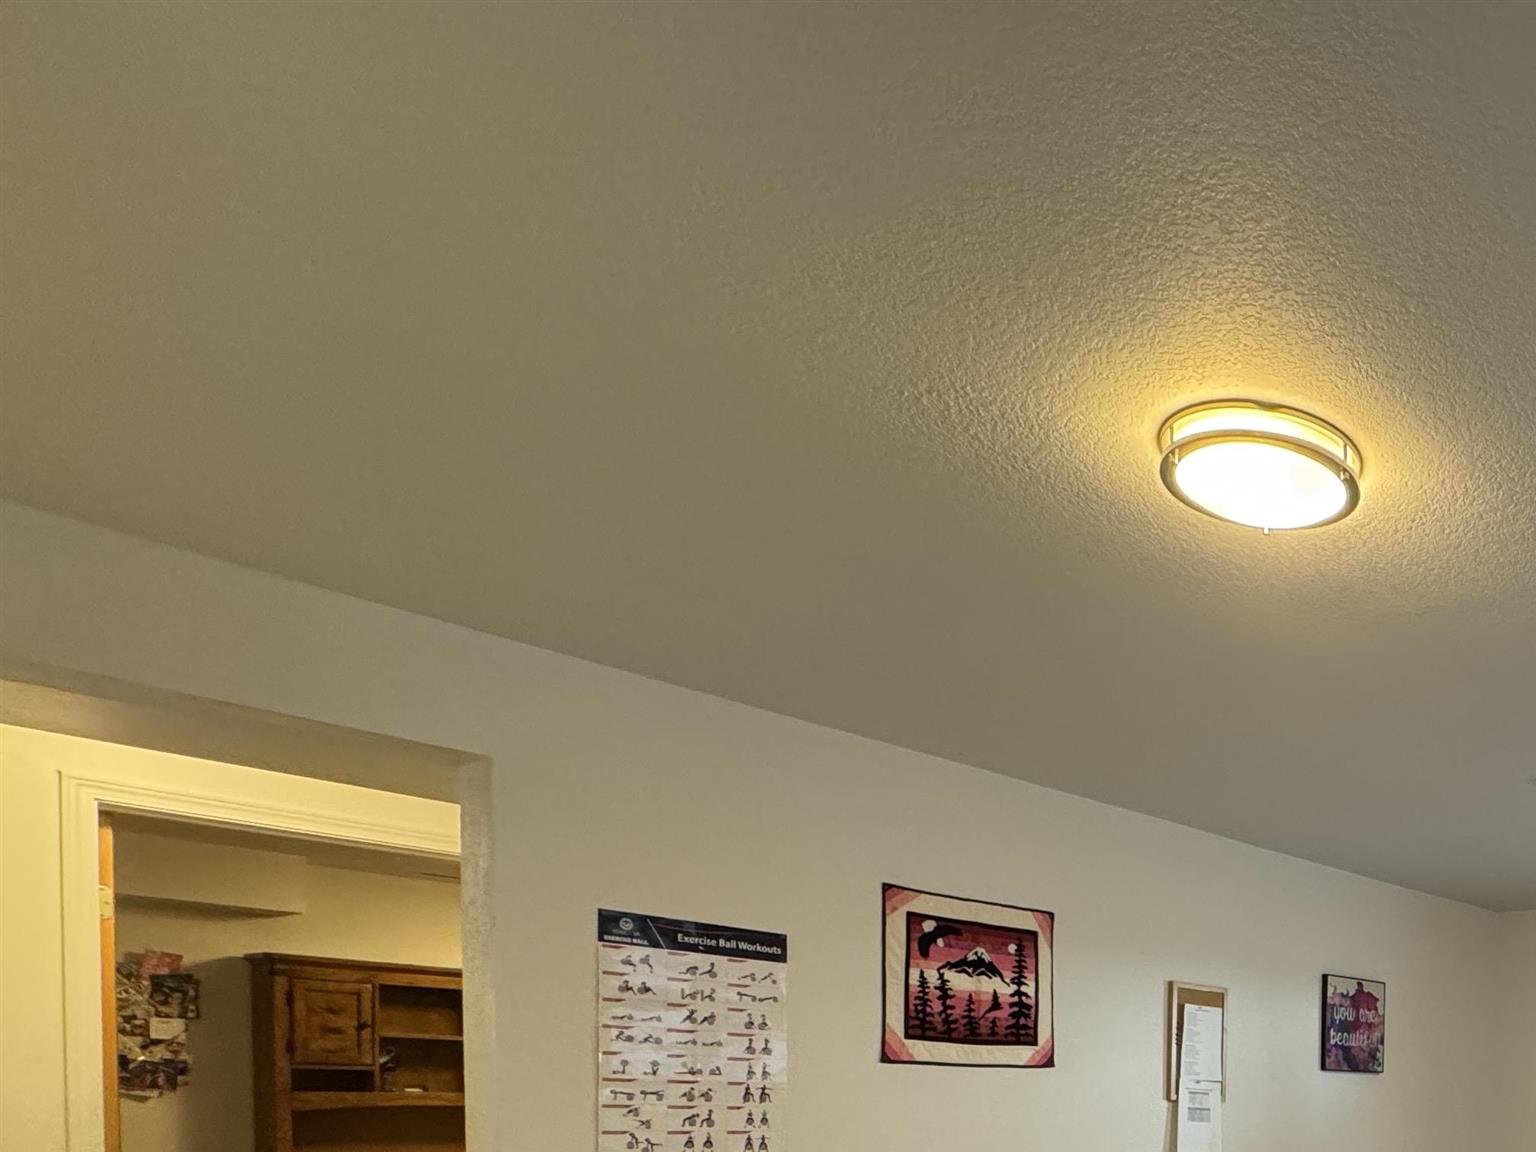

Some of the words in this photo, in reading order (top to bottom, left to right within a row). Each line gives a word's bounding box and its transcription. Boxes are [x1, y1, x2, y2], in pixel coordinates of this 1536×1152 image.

[677, 933, 717, 947] Exercise
[718, 938, 737, 949] Ball
[738, 941, 782, 955] Workouts
[1333, 1006, 1356, 1024] you
[1359, 1008, 1377, 1023] are
